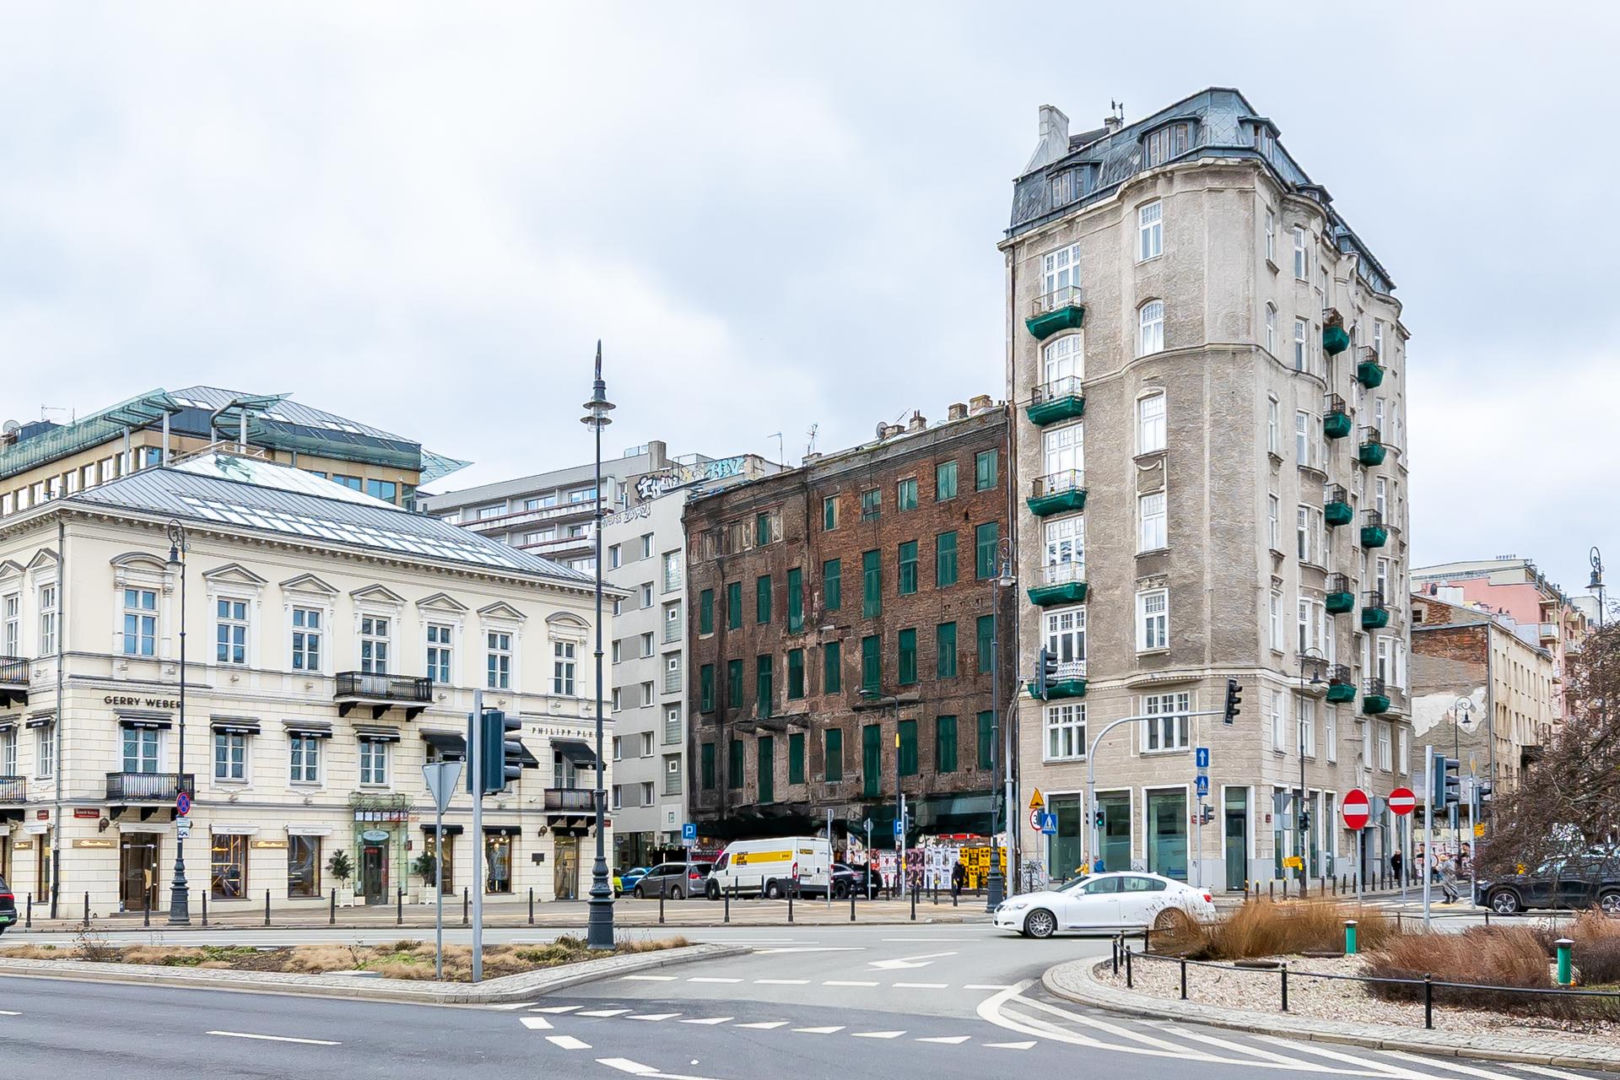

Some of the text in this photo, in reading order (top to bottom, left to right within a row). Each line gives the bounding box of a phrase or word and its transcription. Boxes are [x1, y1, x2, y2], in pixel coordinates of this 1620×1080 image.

[104, 695, 141, 706] GERRY
[532, 727, 572, 736] PHILIPP
[685, 825, 694, 837] P
